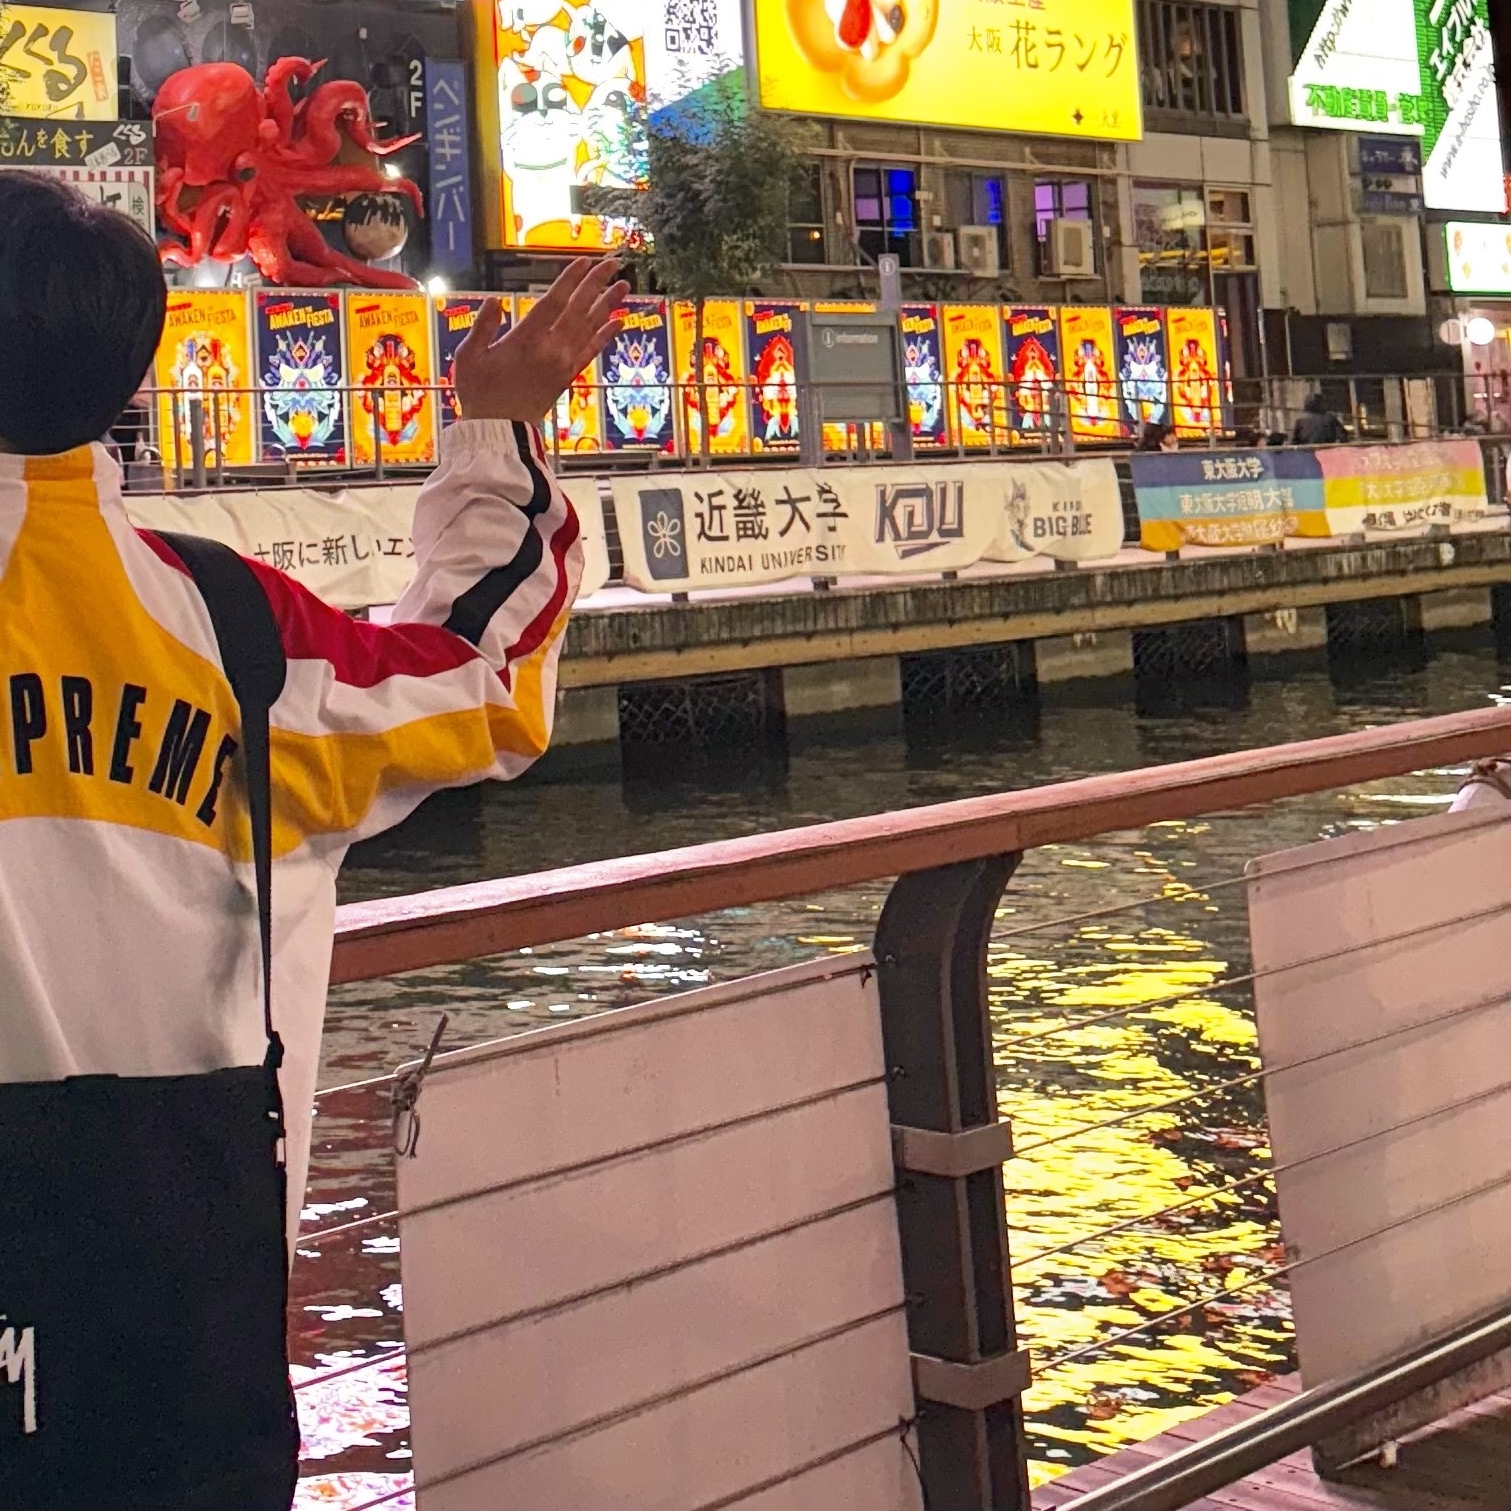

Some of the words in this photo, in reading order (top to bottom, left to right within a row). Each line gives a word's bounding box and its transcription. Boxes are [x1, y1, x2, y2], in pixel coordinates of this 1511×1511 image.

[1008, 19, 1130, 79] 花ラング
[409, 59, 423, 118] 2F
[123, 147, 149, 165] 2F
[168, 308, 206, 328] AWAKEN
[207, 309, 237, 327] FIESTA
[269, 308, 307, 331] AWAKEN
[306, 309, 335, 329] FIESTA
[693, 481, 849, 543] 近畿大学
[1033, 515, 1067, 538] BIG
[1070, 512, 1093, 537] BE
[699, 553, 753, 576] KINDAI
